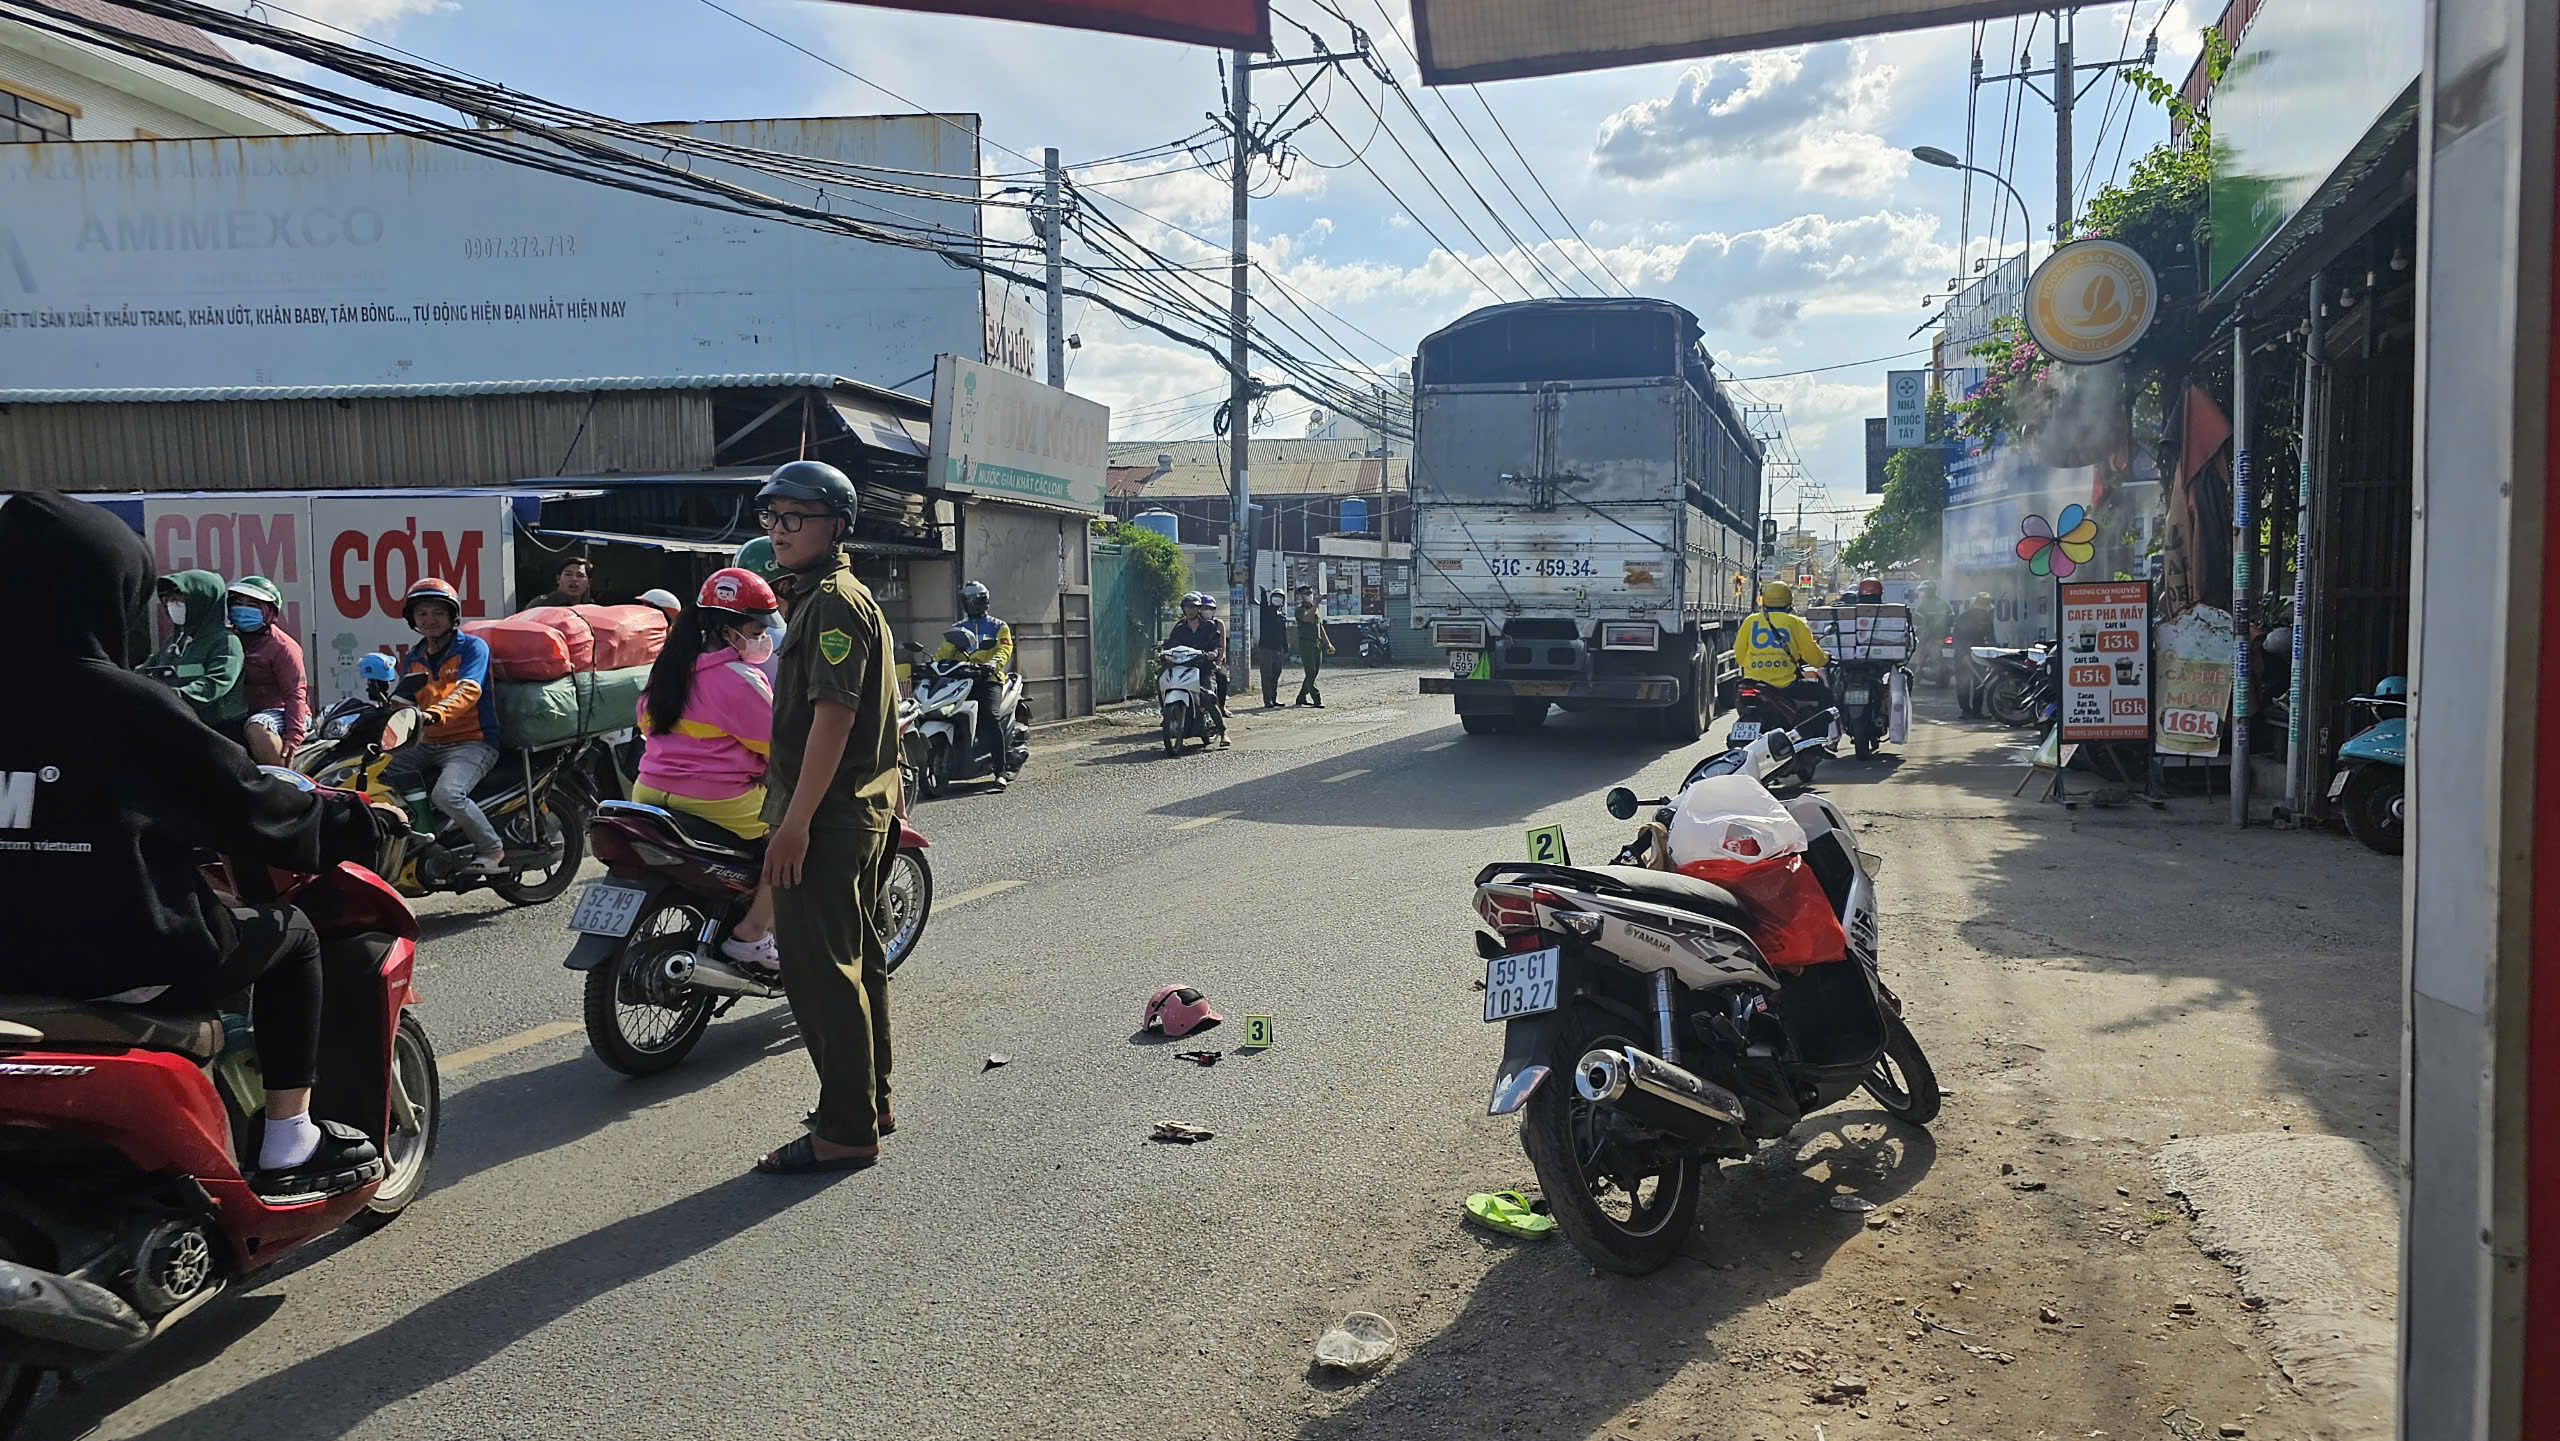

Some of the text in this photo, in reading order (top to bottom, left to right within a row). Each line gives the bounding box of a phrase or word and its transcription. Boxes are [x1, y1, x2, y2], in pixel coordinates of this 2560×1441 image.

[75, 204, 386, 252] AMIMEXCO
[103, 303, 139, 327] KHẨU
[140, 310, 186, 328] TRANG,
[188, 305, 224, 326] KHĂN
[256, 304, 291, 325] KHĂN
[294, 307, 328, 327] BABY,
[331, 303, 358, 323] TĂM
[413, 303, 431, 326] TỰ
[433, 301, 468, 326] ĐỘNG
[471, 300, 501, 325] HIỆN
[504, 303, 526, 325] ĐẠI
[529, 295, 565, 320] NHẤT
[567, 298, 598, 323] HIỆN
[600, 301, 627, 318] NAY
[1897, 398, 1916, 411] NHÀ
[1892, 411, 1921, 426] THUỐC
[1898, 427, 1915, 439] TÂY
[978, 467, 1000, 485] NƯỚC
[154, 512, 298, 584] CƠM
[329, 516, 486, 620] CƠM
[1491, 558, 1521, 577] 51C
[1535, 557, 1591, 577] 459.34
[2067, 605, 2144, 621] CAFE PHA MÁY
[2103, 635, 2135, 649] 13k
[1456, 652, 1473, 662] 51C
[2074, 669, 2106, 683] 15k
[2191, 667, 2226, 685] PHÊ
[2113, 700, 2145, 714] 16k
[2166, 711, 2215, 735] 16k
[33, 840, 92, 853] vietnam
[1536, 833, 1555, 861] 2
[587, 887, 635, 911] 52-N9
[578, 909, 625, 932] 3632
[1632, 929, 1672, 954] YAMAHA
[1495, 951, 1547, 987] 59-G1
[1488, 979, 1554, 1018] 103.27
[1251, 1020, 1264, 1041] 3
